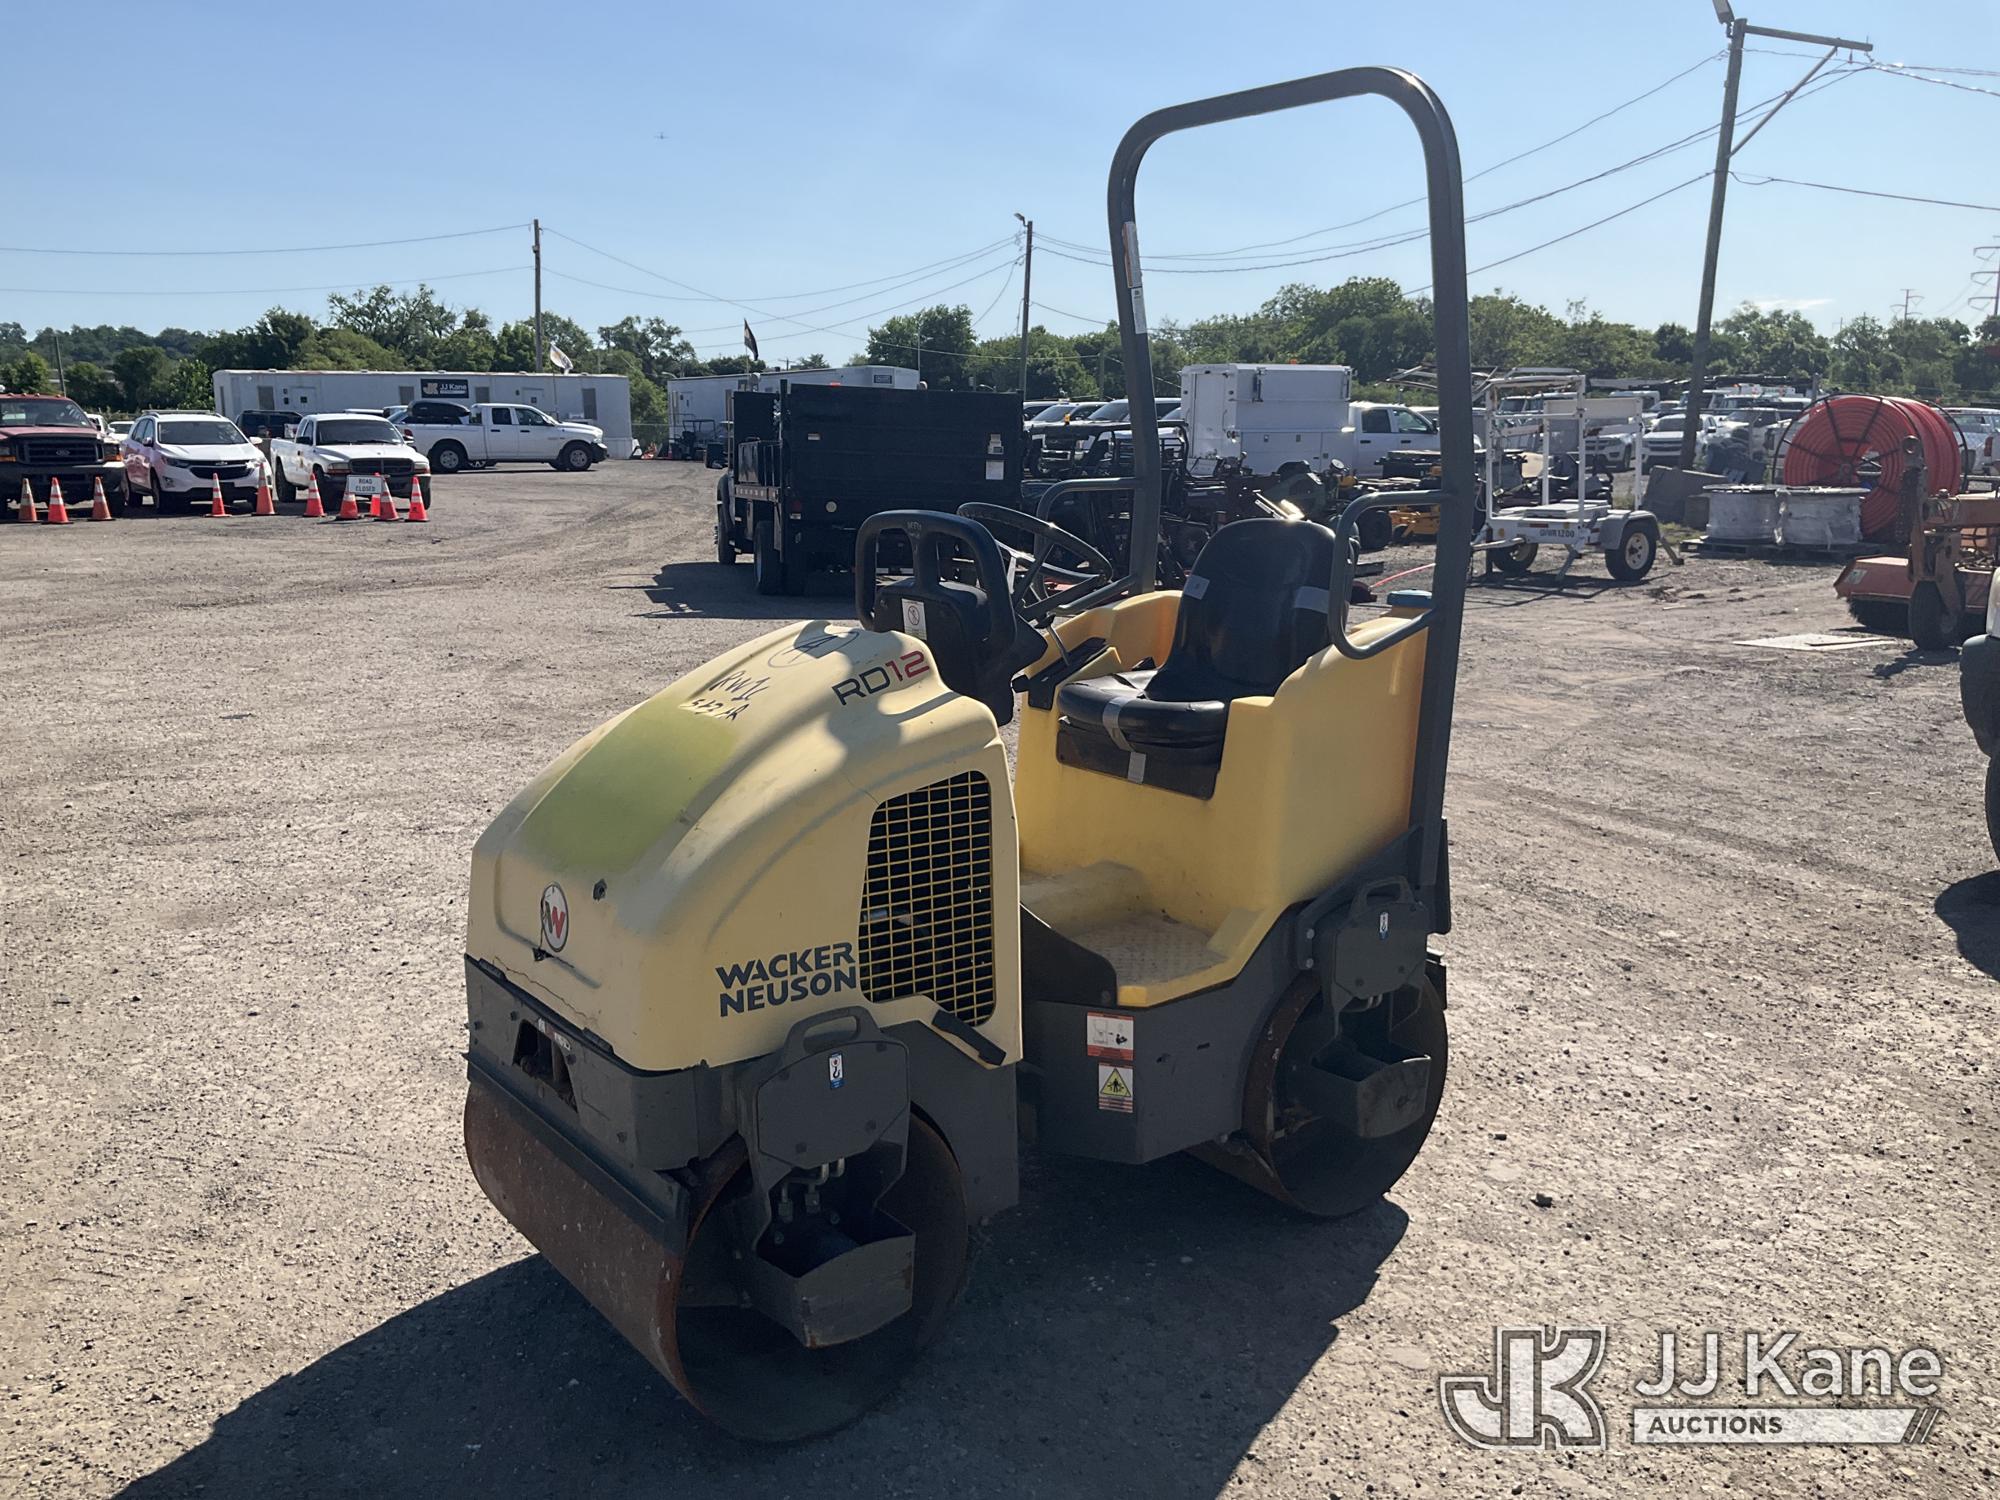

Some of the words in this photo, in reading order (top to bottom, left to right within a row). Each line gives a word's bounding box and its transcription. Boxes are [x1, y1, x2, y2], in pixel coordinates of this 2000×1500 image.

[831, 650, 930, 706] RD12
[715, 941, 856, 989] WACKER
[719, 966, 857, 1018] NEUSON
